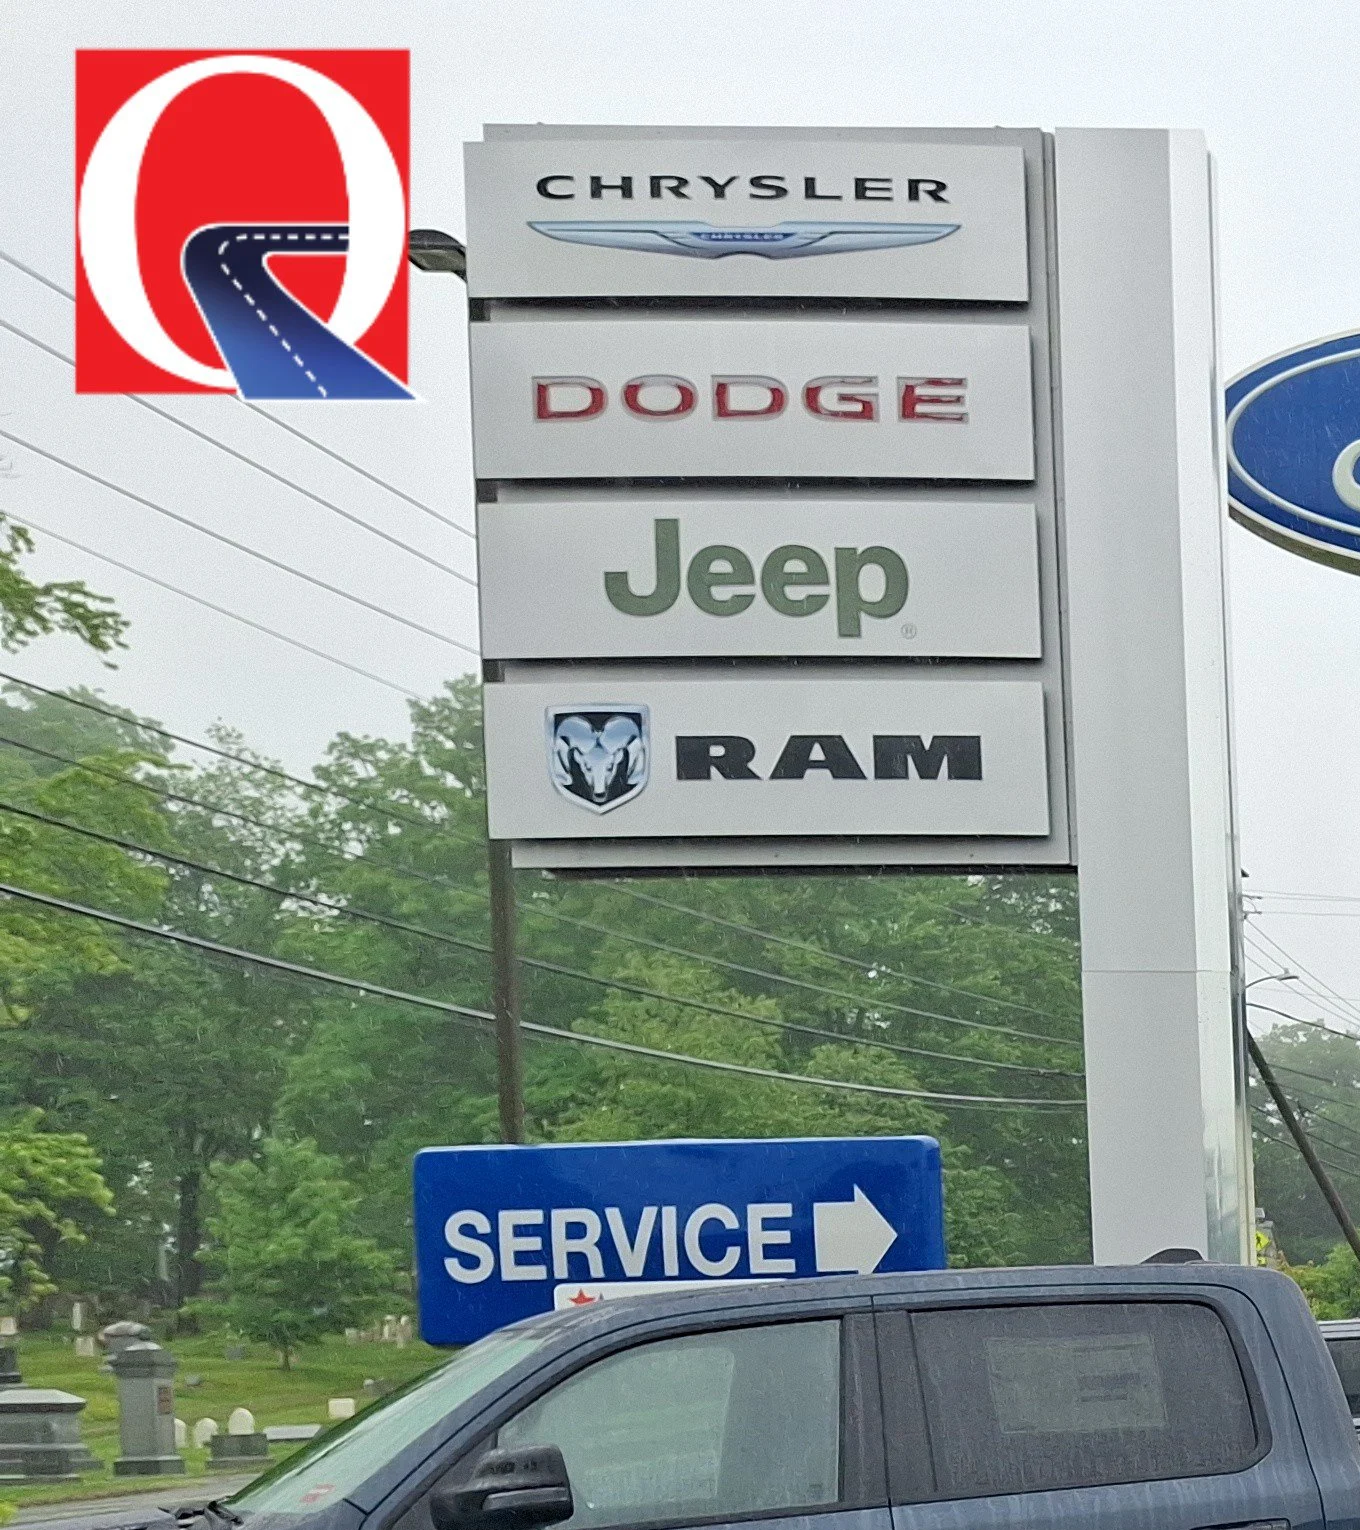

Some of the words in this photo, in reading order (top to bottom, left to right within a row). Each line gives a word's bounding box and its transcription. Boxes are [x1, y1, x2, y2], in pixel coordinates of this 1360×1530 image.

[535, 174, 952, 204] CHRYSLER
[530, 374, 969, 424] DODGE
[603, 518, 910, 639] Jeep
[674, 735, 984, 781] RAM
[443, 1202, 797, 1284] SERVICE
